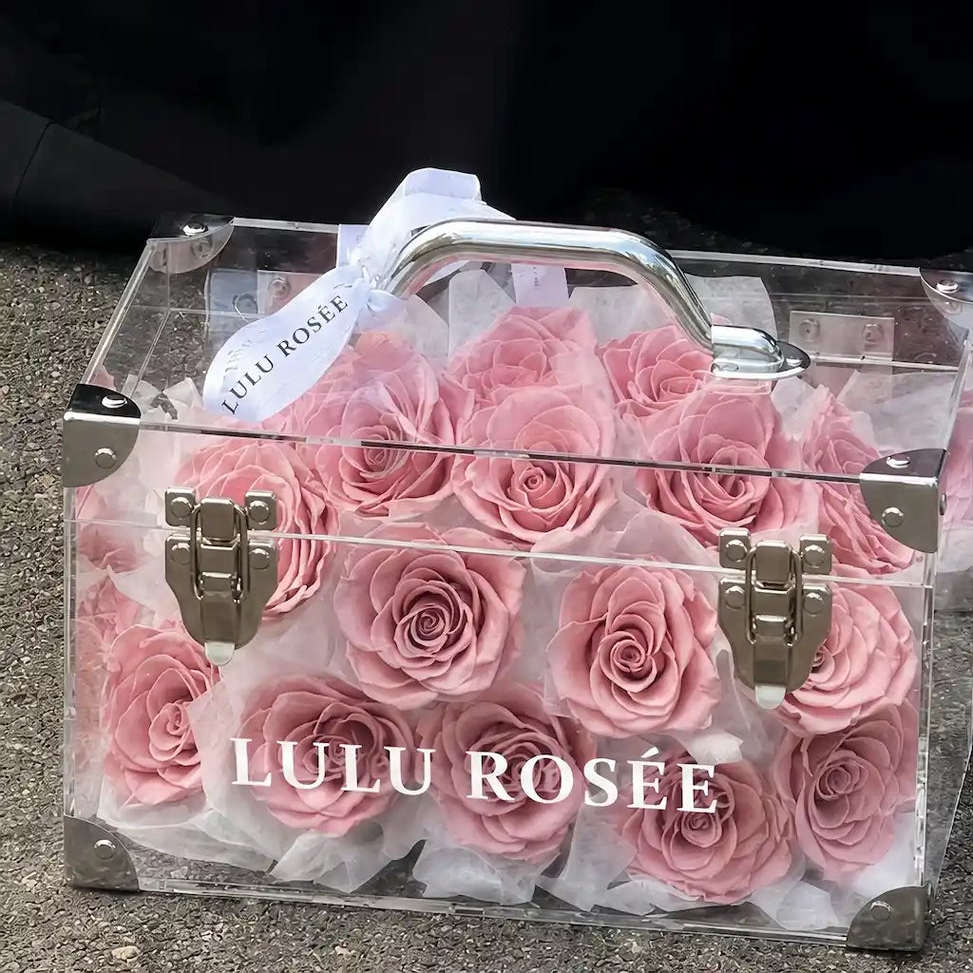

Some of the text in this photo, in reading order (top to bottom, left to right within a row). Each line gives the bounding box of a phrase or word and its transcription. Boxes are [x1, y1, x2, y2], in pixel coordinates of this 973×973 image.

[221, 354, 274, 415] LULU
[276, 295, 348, 357] ROSÉE
[229, 737, 718, 814] LULU ROSÉE
